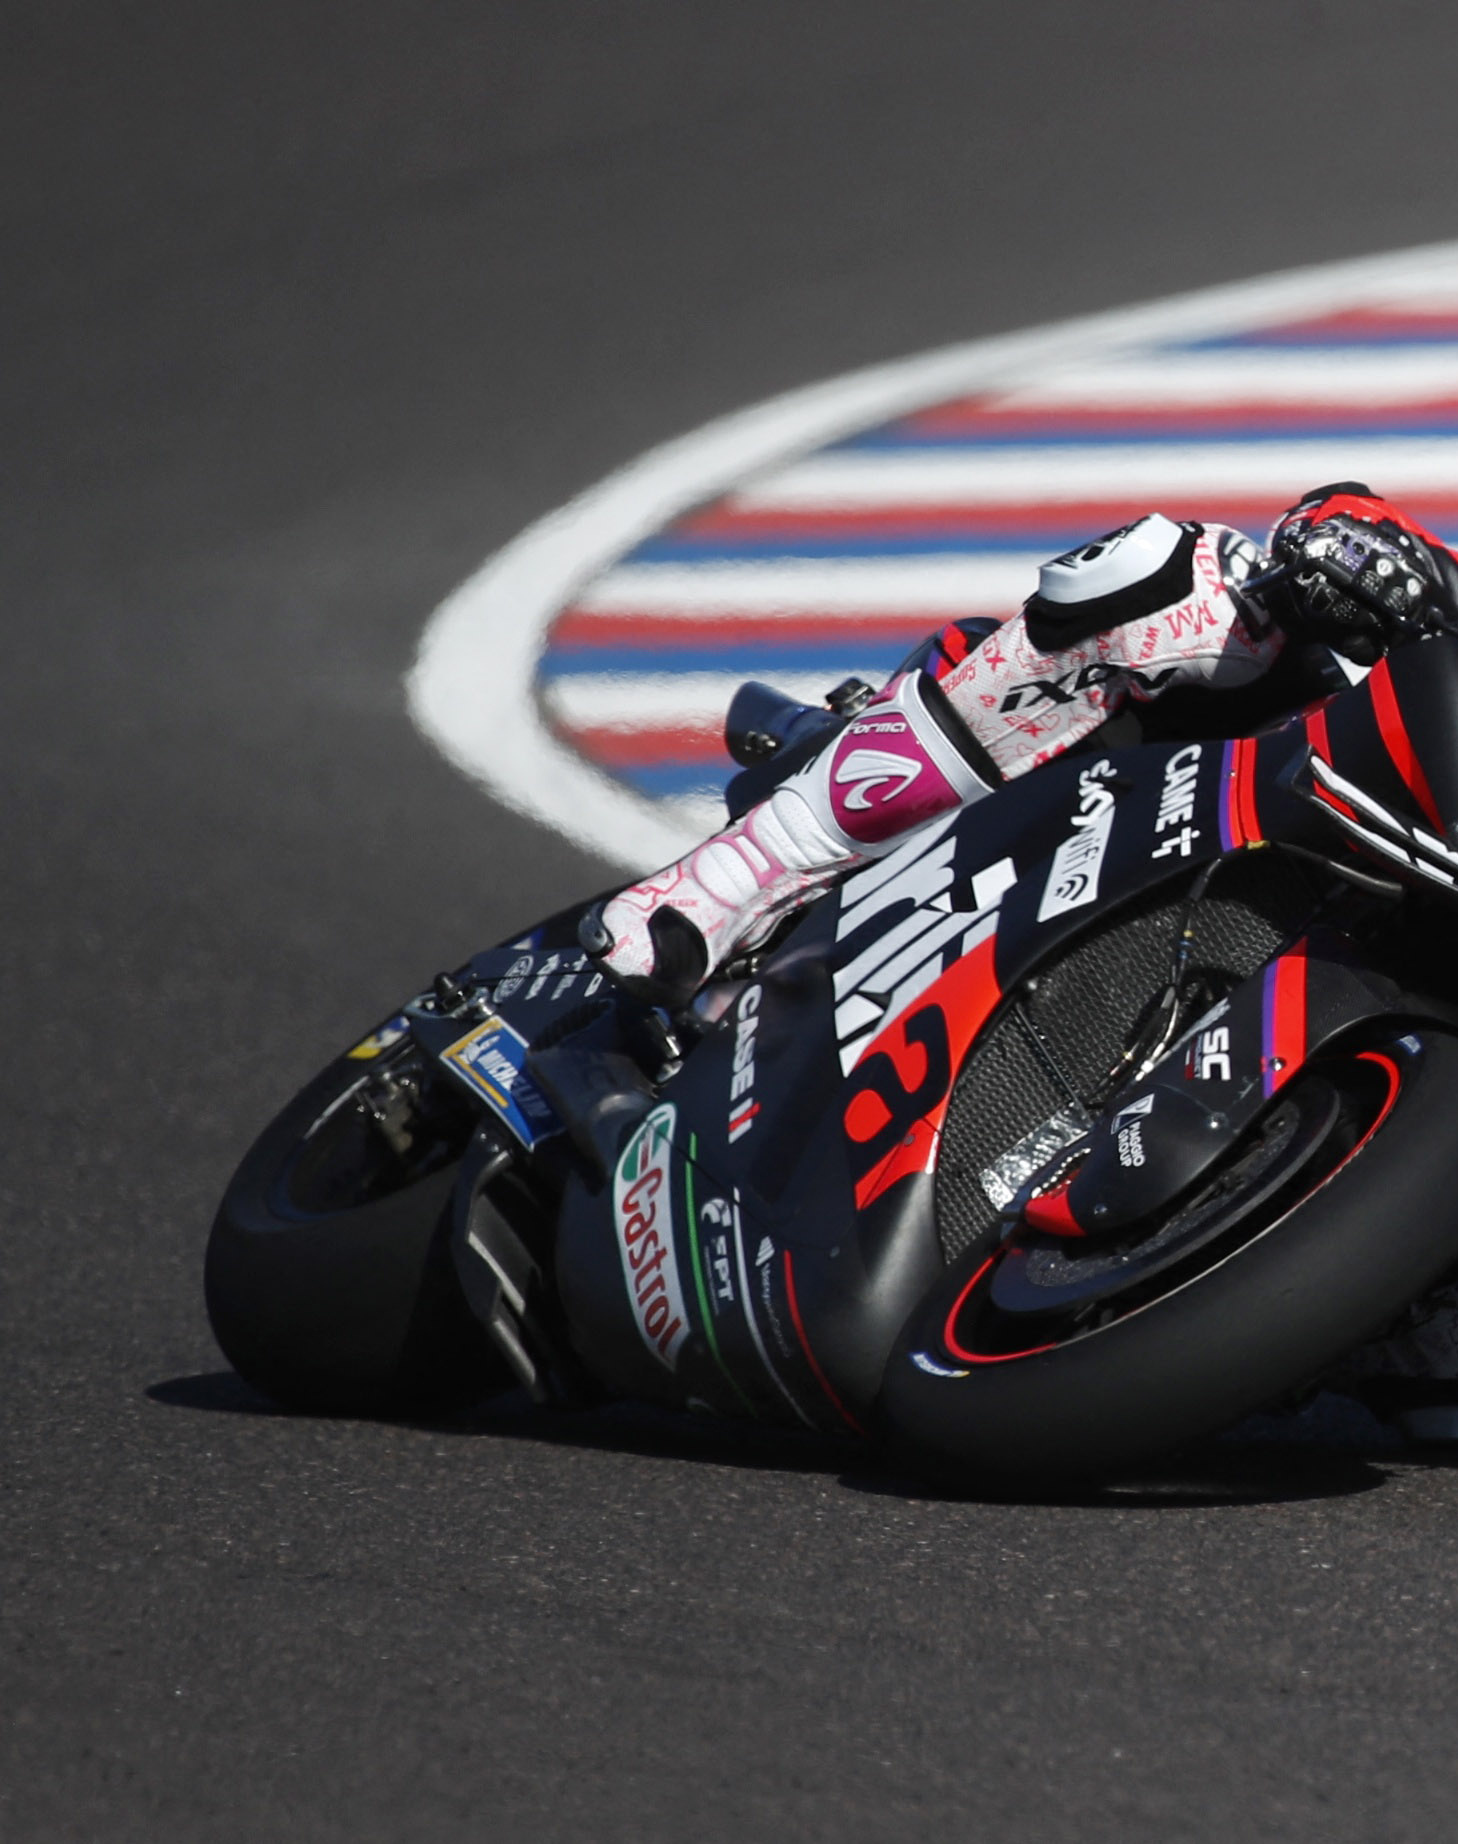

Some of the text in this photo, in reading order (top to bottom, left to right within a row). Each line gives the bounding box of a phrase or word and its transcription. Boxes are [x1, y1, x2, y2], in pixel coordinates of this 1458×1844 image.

[1154, 743, 1203, 833] CAME
[729, 983, 763, 1102] CASE
[1201, 1026, 1232, 1081] SC
[1117, 1128, 1133, 1168] GROUP
[1128, 1120, 1146, 1168] PIAGGIO
[622, 1166, 683, 1360] Castrol
